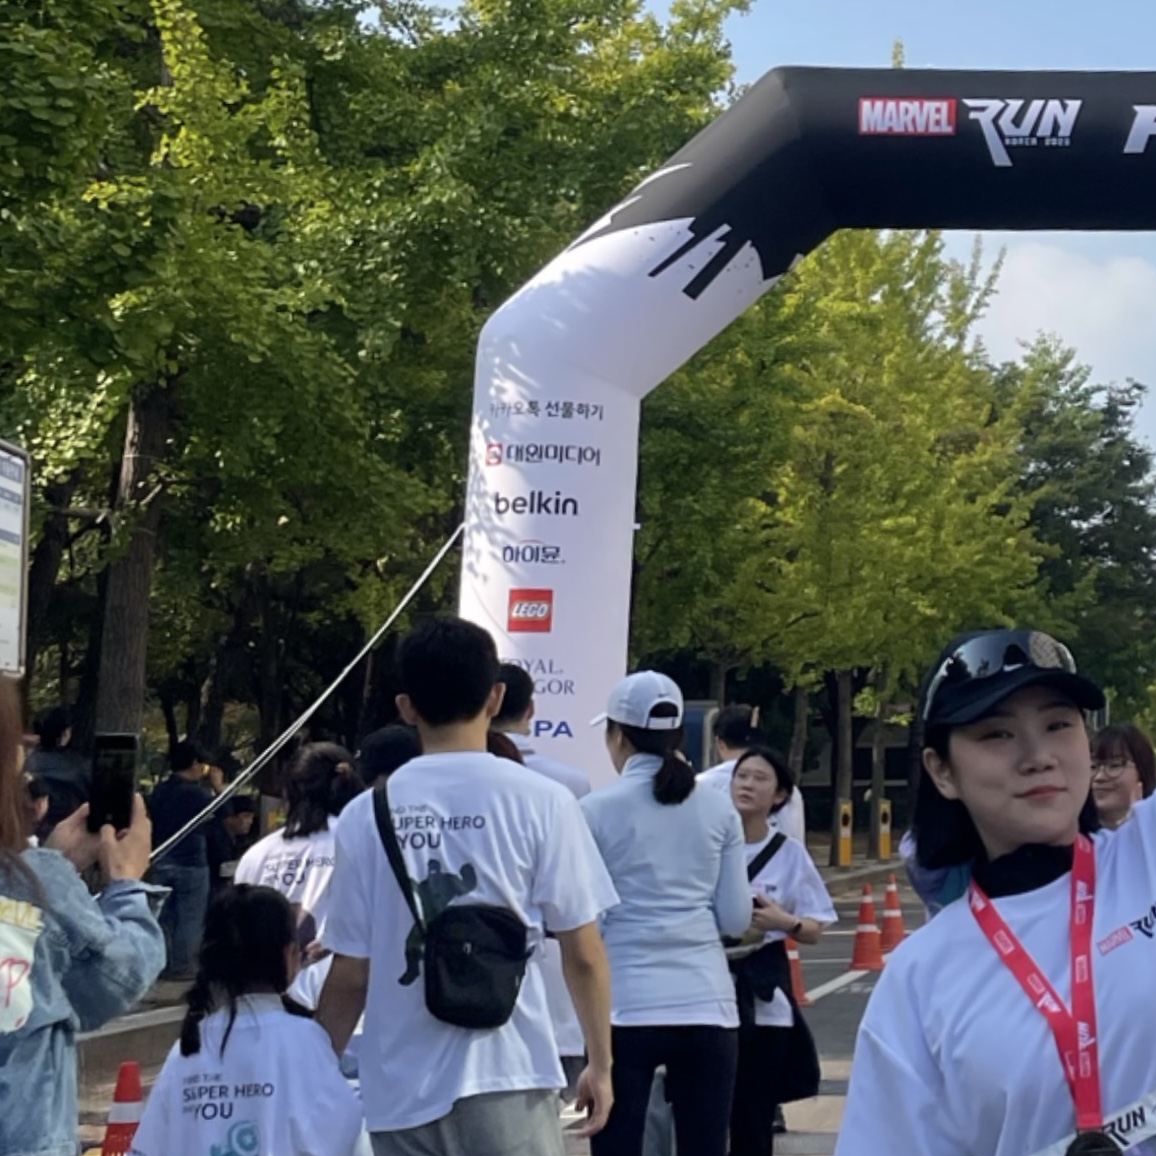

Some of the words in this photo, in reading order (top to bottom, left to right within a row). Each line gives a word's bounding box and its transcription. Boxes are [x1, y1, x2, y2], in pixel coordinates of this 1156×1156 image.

[860, 99, 954, 134] MARVEL
[962, 98, 1083, 167] RUN
[545, 401, 604, 420] 선물하기
[506, 442, 601, 466] 대원미디어
[495, 491, 579, 516] belkin
[511, 602, 549, 618] LEGO
[395, 815, 435, 830] UPER
[440, 815, 486, 830] HERO
[396, 832, 441, 850] YOU
[234, 1082, 275, 1099] HERO
[1103, 1105, 1146, 1147] RUN
